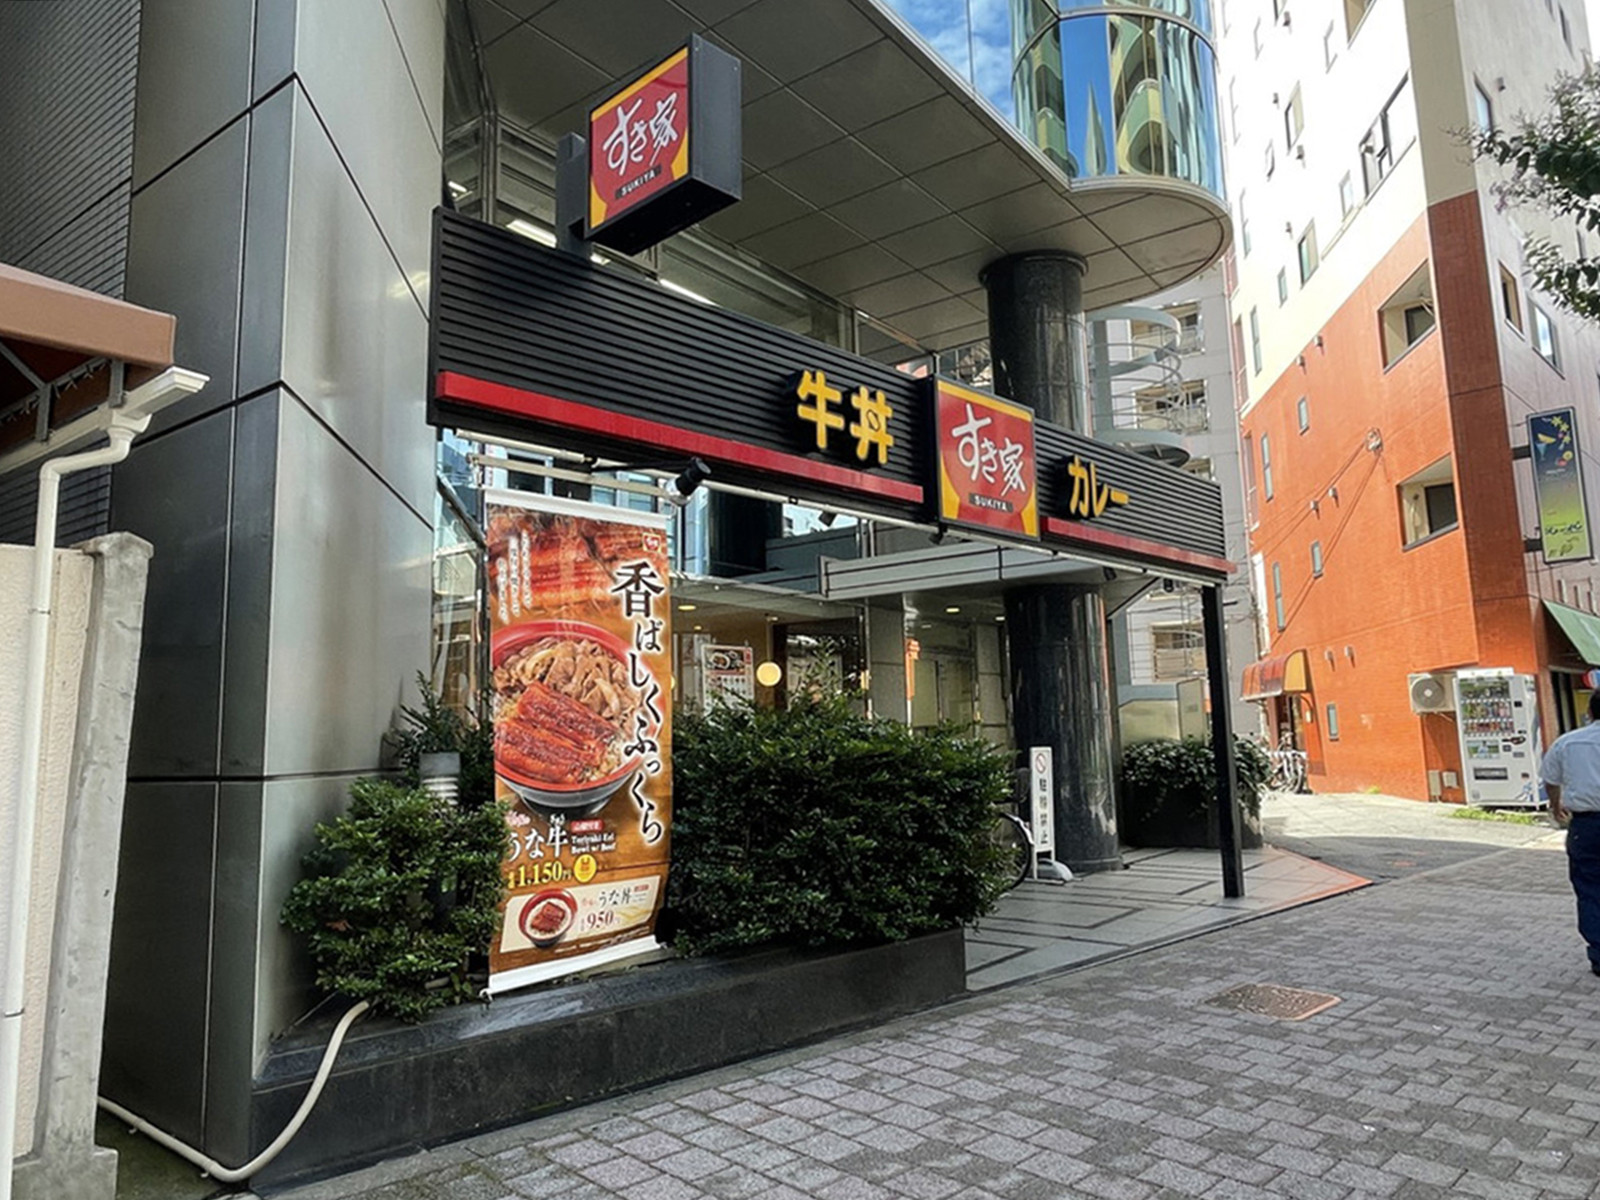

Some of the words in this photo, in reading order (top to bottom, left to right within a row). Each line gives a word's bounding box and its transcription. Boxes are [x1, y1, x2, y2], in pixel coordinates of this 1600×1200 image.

[603, 92, 678, 176] すき家
[621, 170, 655, 195] SUKIYA
[796, 369, 895, 466] 牛丼
[951, 402, 1027, 496] すき家
[973, 496, 1009, 513] SUKIYA
[1067, 454, 1130, 518] カレー
